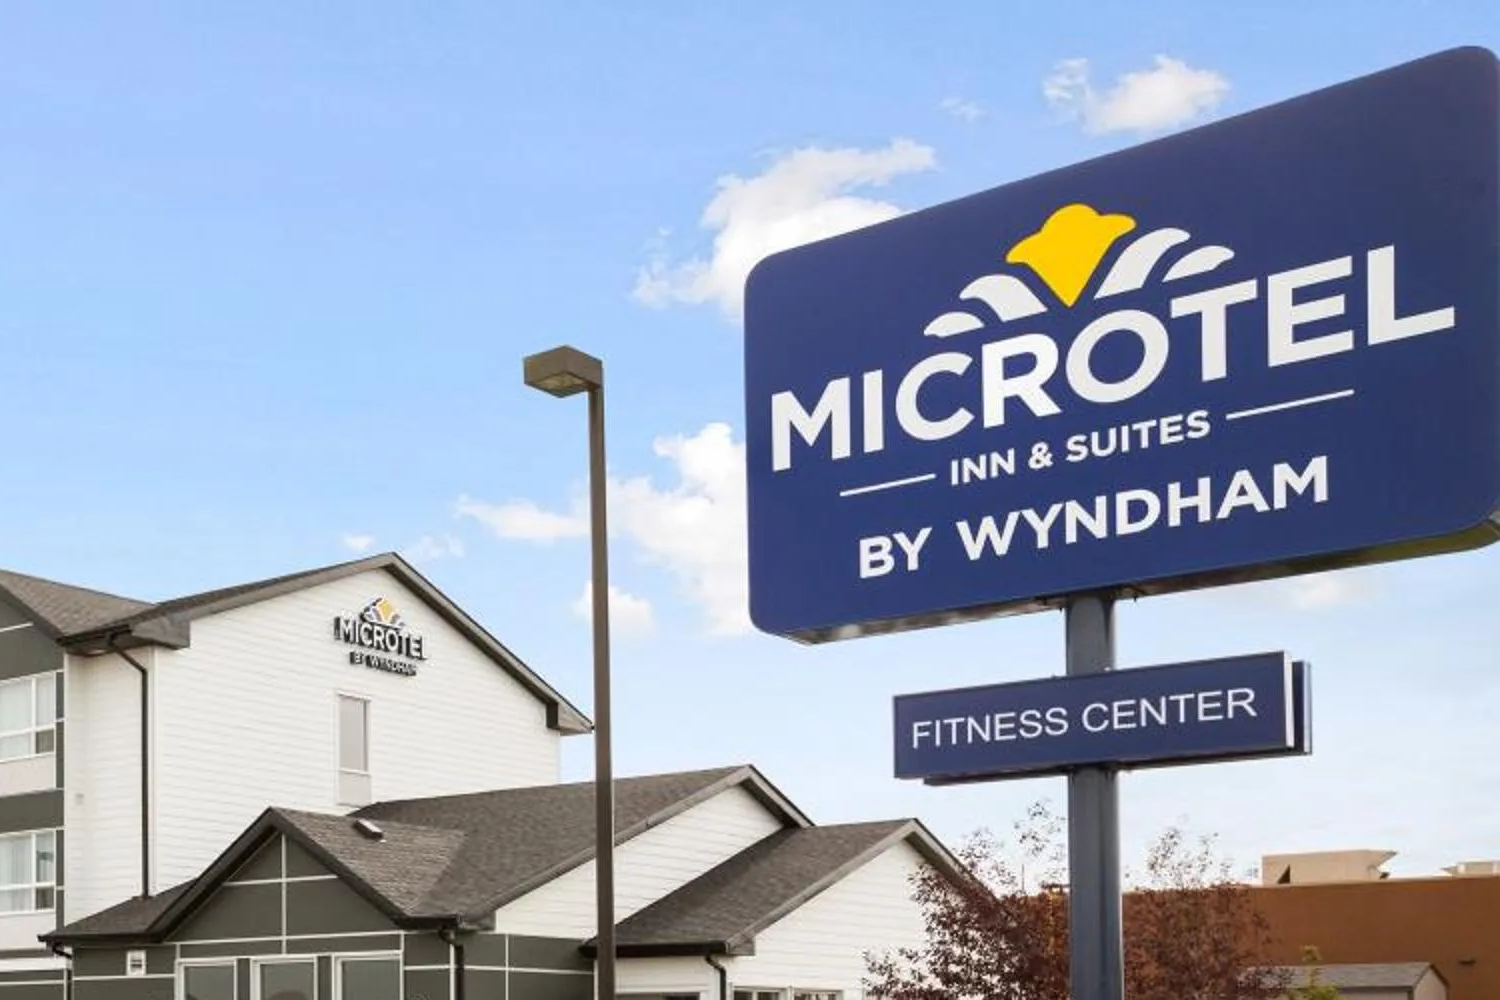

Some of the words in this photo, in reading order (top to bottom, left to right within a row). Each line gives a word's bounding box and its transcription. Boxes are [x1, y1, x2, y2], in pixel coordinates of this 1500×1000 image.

[771, 245, 1456, 472] MICROTEL
[951, 448, 1015, 486] INN
[1028, 442, 1054, 470] &
[1065, 409, 1212, 462] SUITES
[859, 527, 933, 579] BY
[955, 455, 1329, 561] WYNDHAM
[334, 614, 427, 660] MICROTEL
[912, 707, 1069, 749] FITNESS
[1081, 687, 1257, 733] CENTER
